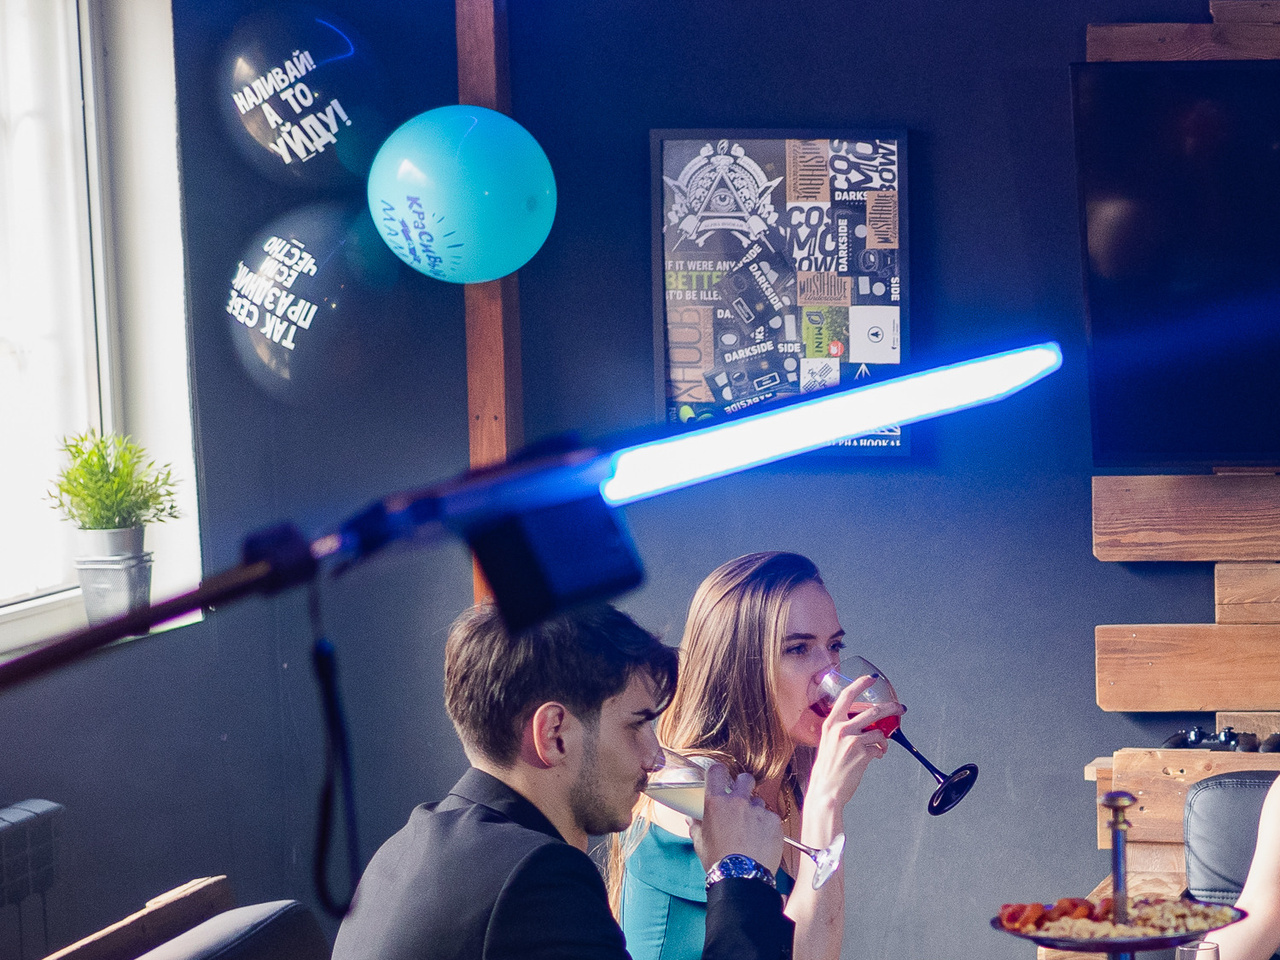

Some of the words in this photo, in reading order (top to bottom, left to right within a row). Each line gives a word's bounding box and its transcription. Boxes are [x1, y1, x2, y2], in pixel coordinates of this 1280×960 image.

[232, 50, 316, 115] НАЛИВАЙ!
[261, 102, 284, 129] А
[280, 82, 314, 114] ТО
[269, 98, 352, 164] УЙДУ!
[263, 236, 318, 277] ЧЕСТНО
[838, 218, 848, 272] DARKSIDE
[259, 255, 300, 289] ЕСЛИ
[665, 271, 728, 290] BETTE
[686, 261, 713, 271] WERE
[684, 290, 698, 301] BE
[749, 262, 784, 312] DARKSIDE
[226, 290, 259, 327] СЕБЕ
[260, 312, 297, 350] ТАК
[724, 341, 775, 363] DARKSIDE
